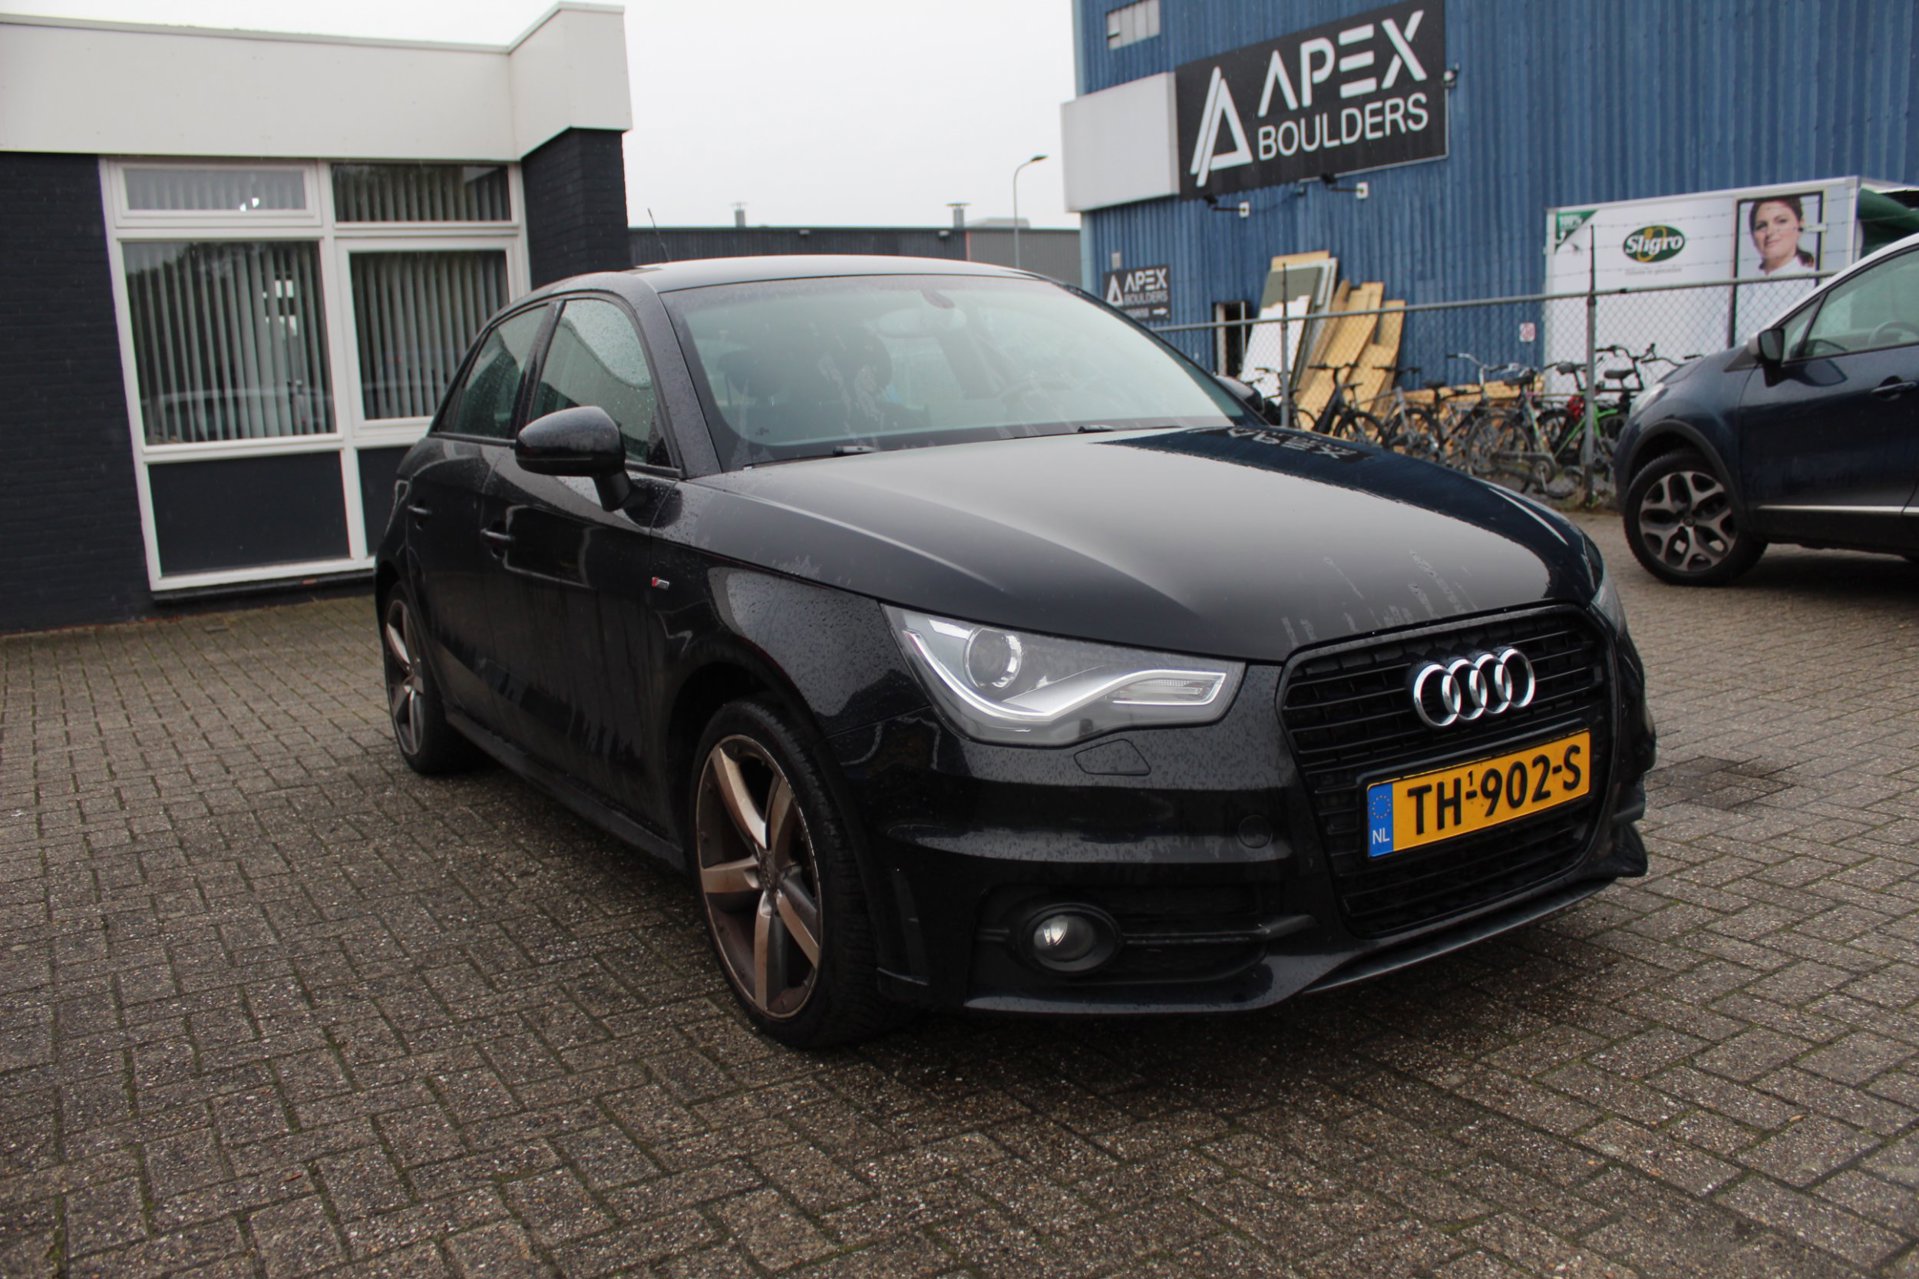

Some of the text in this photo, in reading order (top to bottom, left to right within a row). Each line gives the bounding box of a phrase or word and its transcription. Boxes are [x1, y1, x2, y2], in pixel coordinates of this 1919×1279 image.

[1258, 10, 1428, 118] APEX
[1258, 92, 1429, 161] BOULDERS
[1625, 234, 1684, 256] Sligro
[1124, 268, 1168, 293] APEX
[1407, 744, 1581, 836] TH-902-S
[1372, 828, 1390, 845] NL
